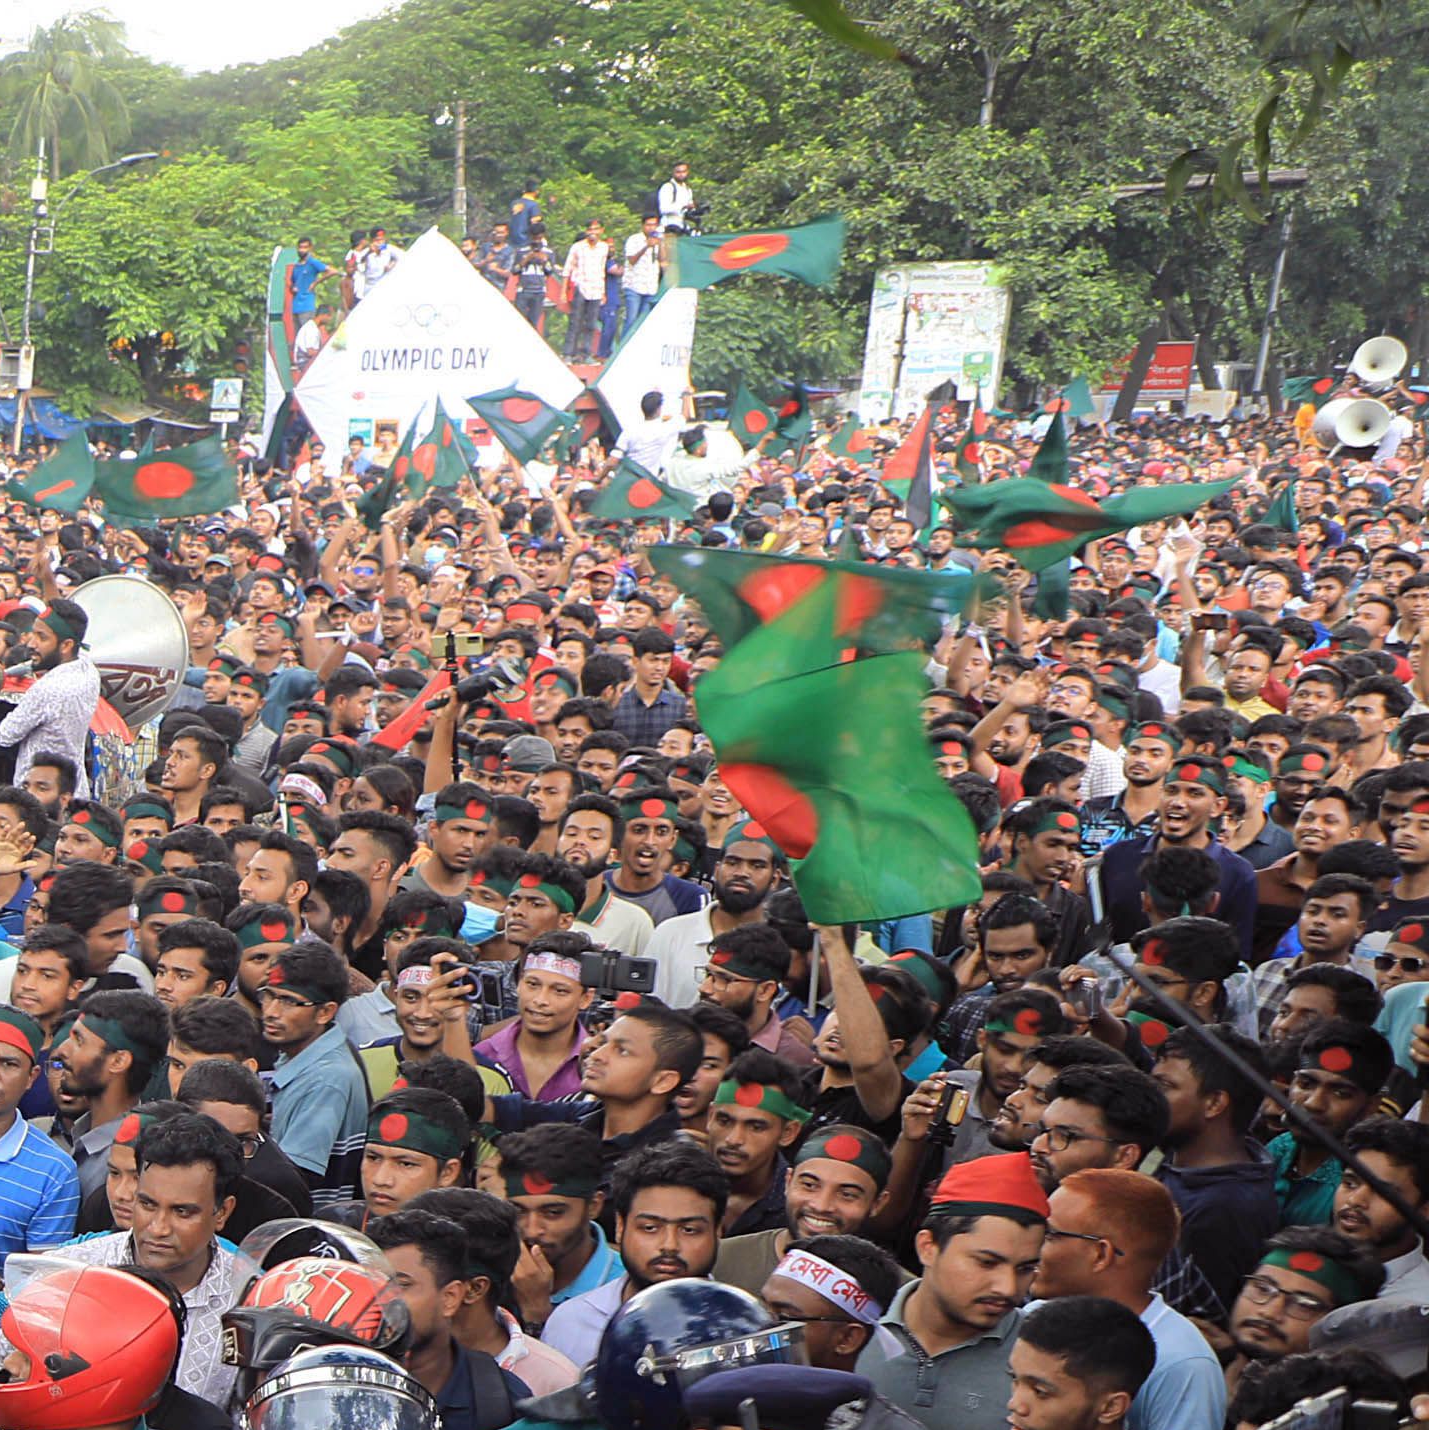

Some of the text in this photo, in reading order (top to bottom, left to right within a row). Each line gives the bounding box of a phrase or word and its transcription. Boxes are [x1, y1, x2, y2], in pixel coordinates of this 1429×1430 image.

[361, 347, 490, 372] OLYMPIC DAY
[790, 1256, 871, 1312] মেধা মেধা
